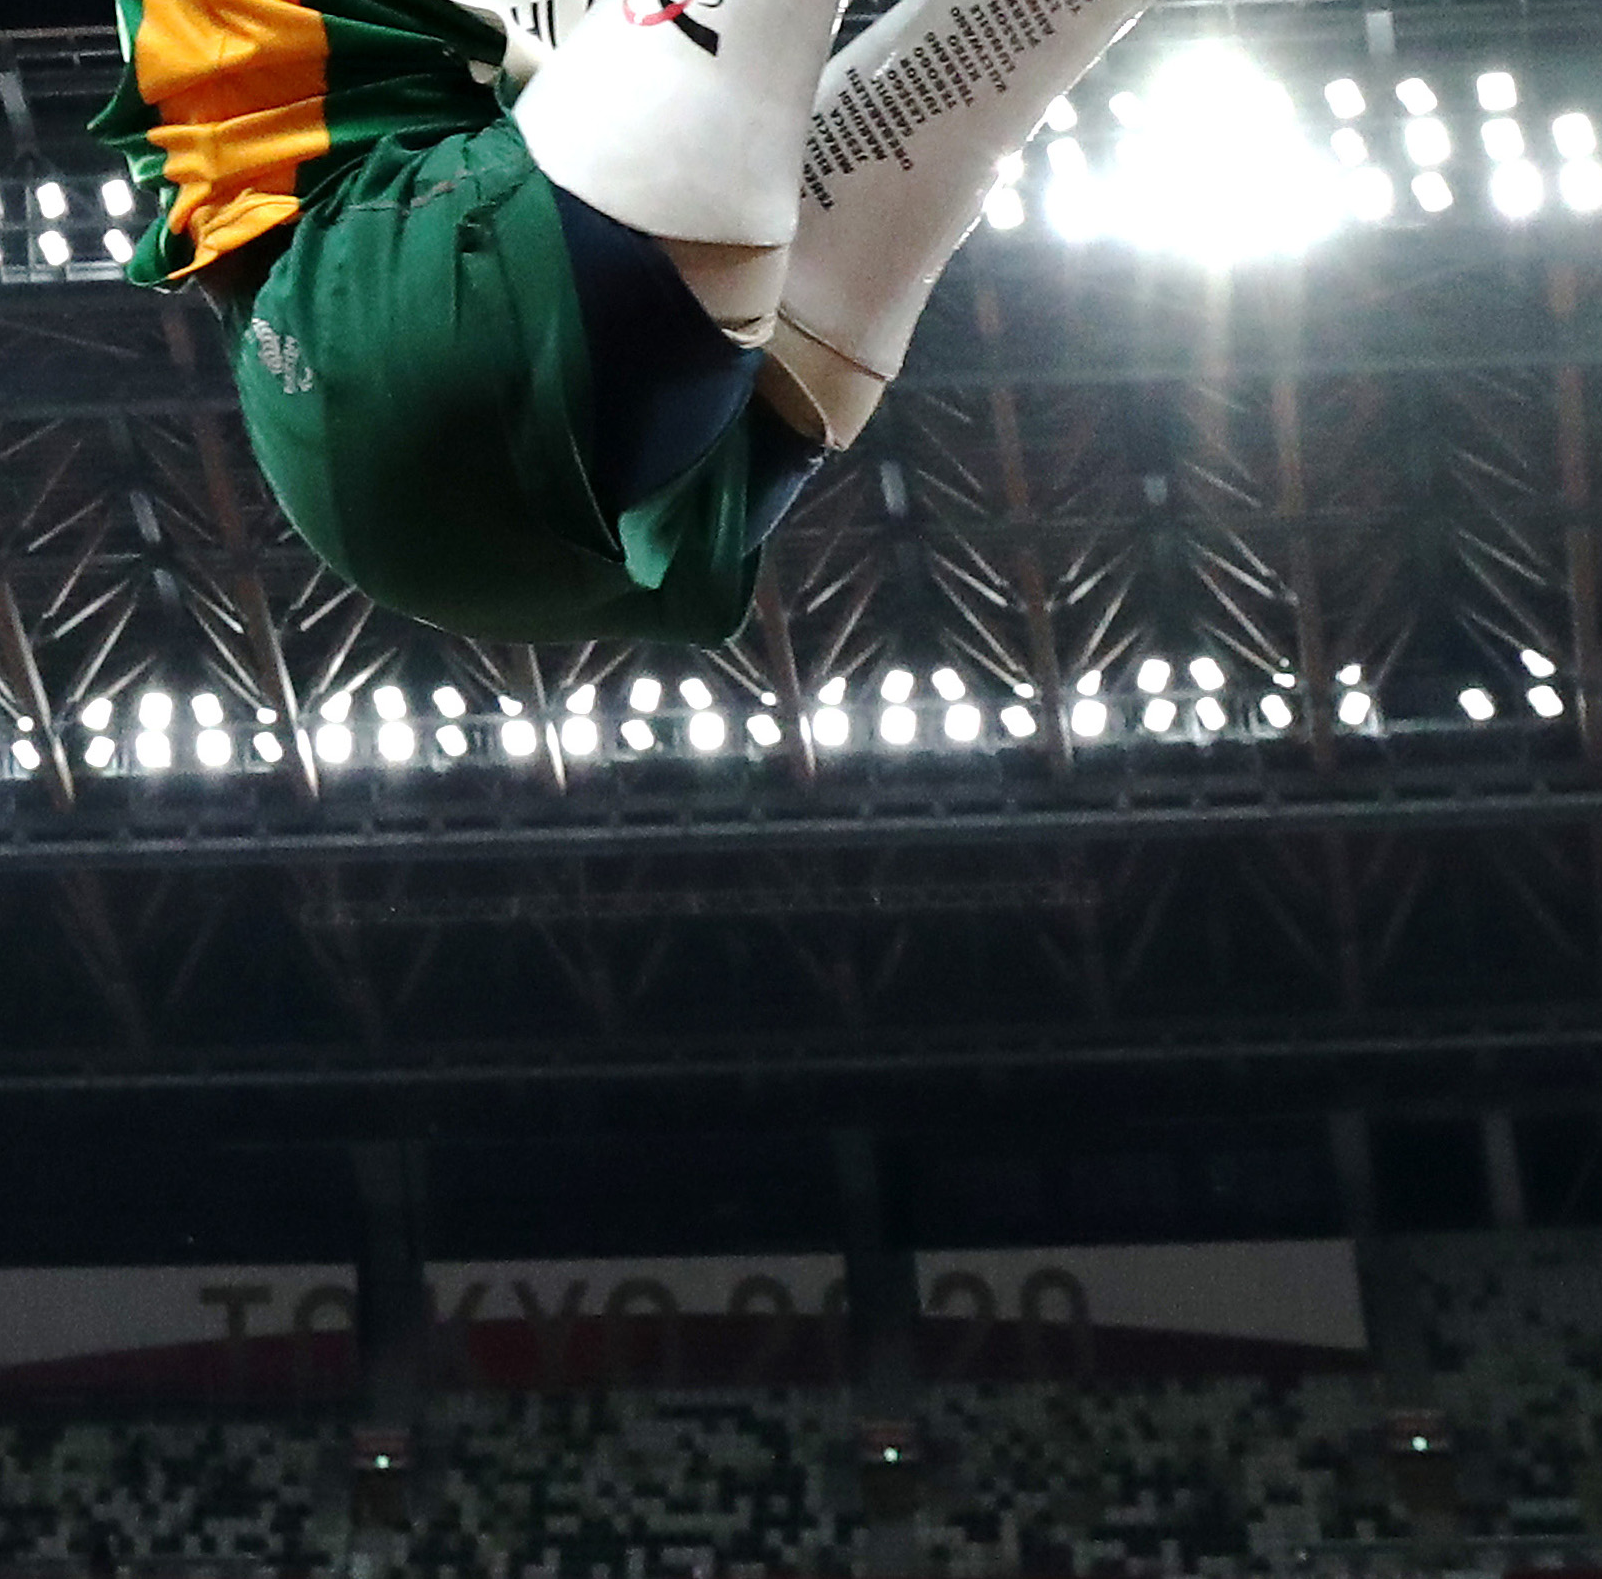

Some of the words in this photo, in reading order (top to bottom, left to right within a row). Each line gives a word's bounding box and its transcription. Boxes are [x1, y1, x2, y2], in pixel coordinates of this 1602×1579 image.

[886, 69, 927, 125] LESEGO
[899, 58, 943, 116] JUNIOR
[829, 108, 869, 163] JESSICA
[200, 1278, 679, 1396] TOKYO
